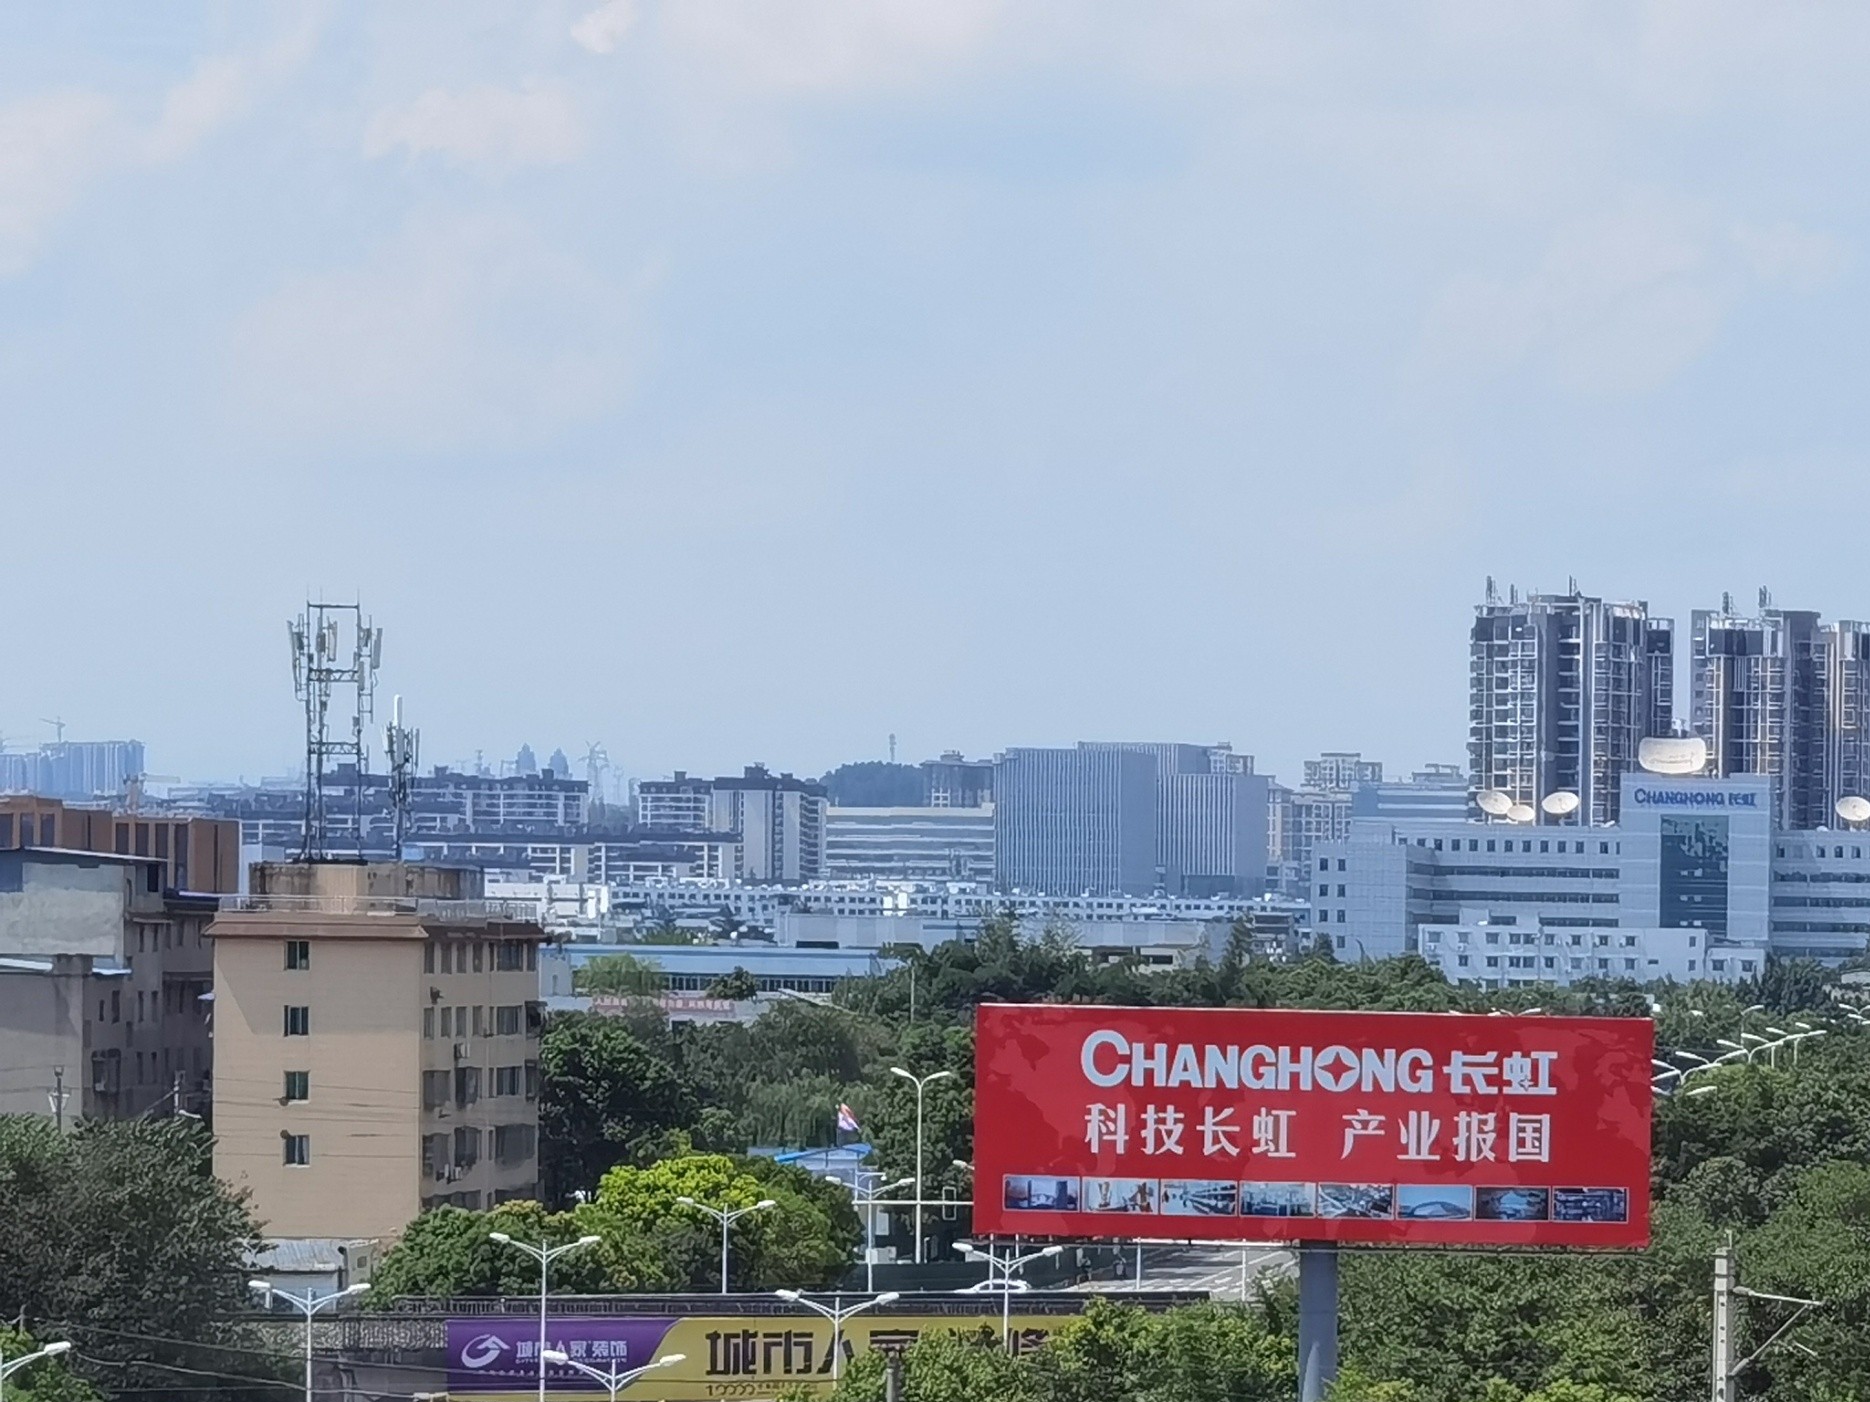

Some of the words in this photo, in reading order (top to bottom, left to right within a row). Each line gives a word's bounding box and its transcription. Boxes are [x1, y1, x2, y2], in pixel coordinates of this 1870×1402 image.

[1634, 788, 1725, 806] CHANGHONG
[1081, 1029, 1433, 1093] CHANGHONG
[1442, 1050, 1557, 1096] 长虹
[1084, 1102, 1297, 1158] 科技长虹
[1341, 1108, 1551, 1164] 产业报国
